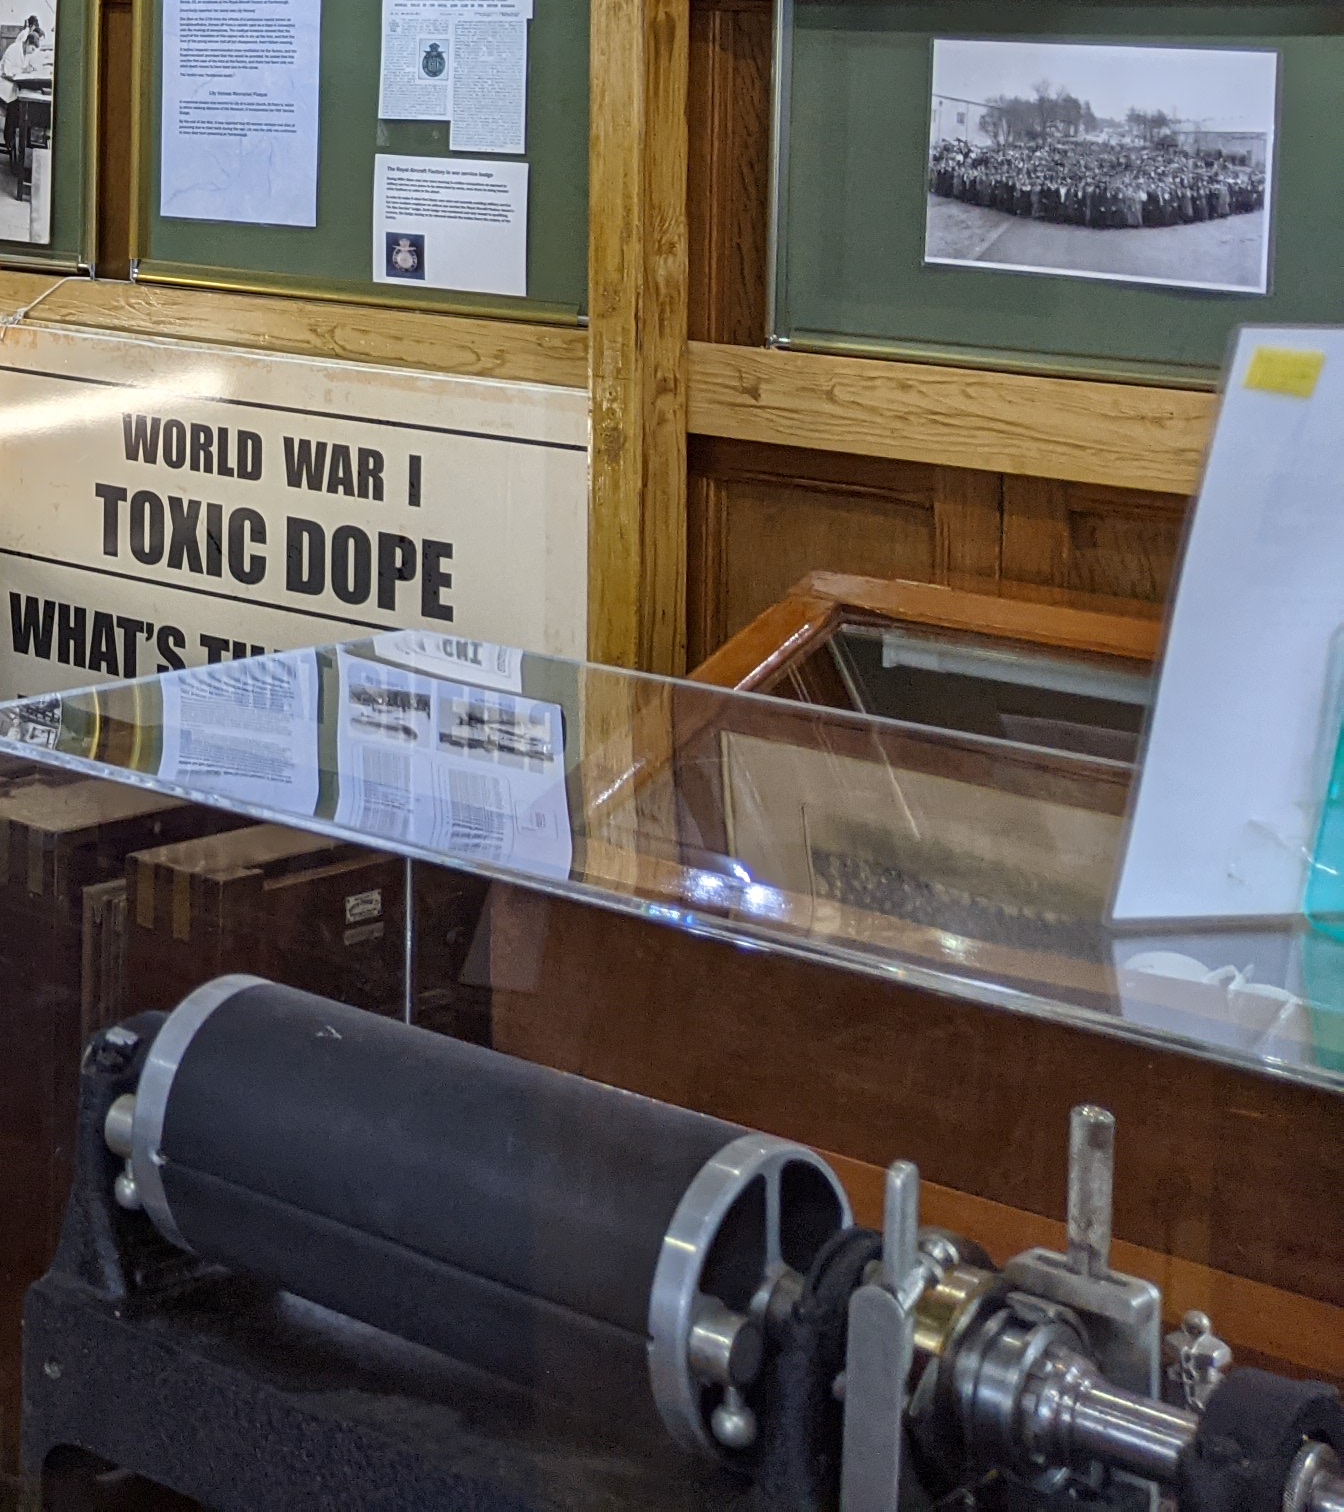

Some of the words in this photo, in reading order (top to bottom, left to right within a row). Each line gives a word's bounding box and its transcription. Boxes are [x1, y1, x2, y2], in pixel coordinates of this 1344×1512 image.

[121, 413, 264, 486] WORLD
[283, 430, 385, 502] WAR
[408, 454, 423, 510] I
[94, 482, 269, 587] TOXIC
[288, 516, 454, 621] DOPE
[9, 591, 187, 678] WHAT'S
